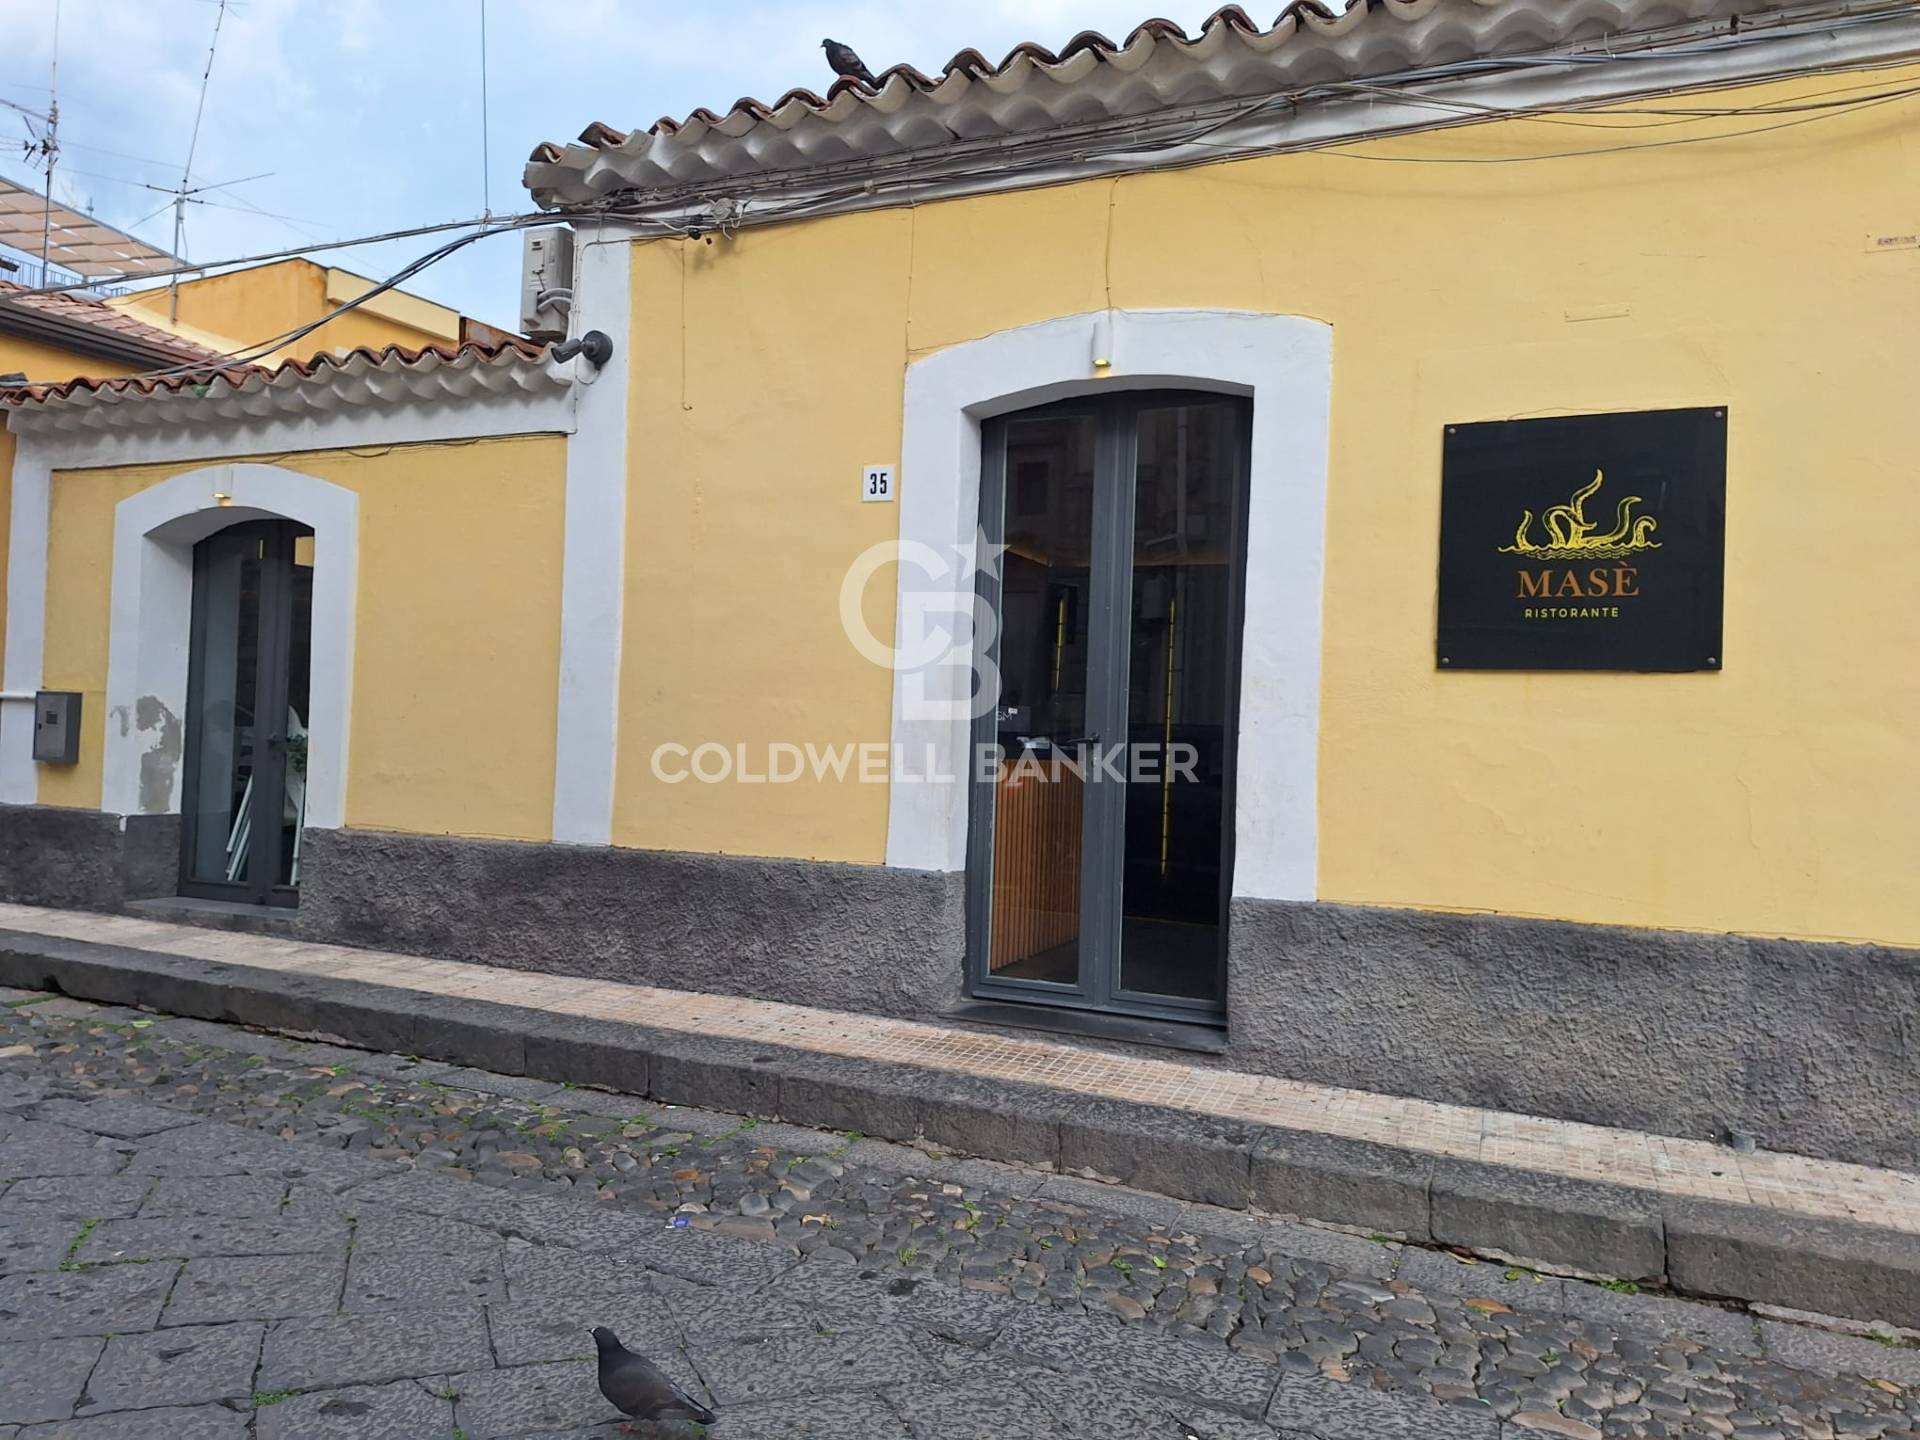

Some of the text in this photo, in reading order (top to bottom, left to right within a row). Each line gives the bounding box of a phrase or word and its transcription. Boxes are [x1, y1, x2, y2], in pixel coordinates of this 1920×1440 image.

[870, 472, 888, 495] 35
[1516, 560, 1640, 599] MASÈ
[1524, 606, 1620, 619] RISTORANTE
